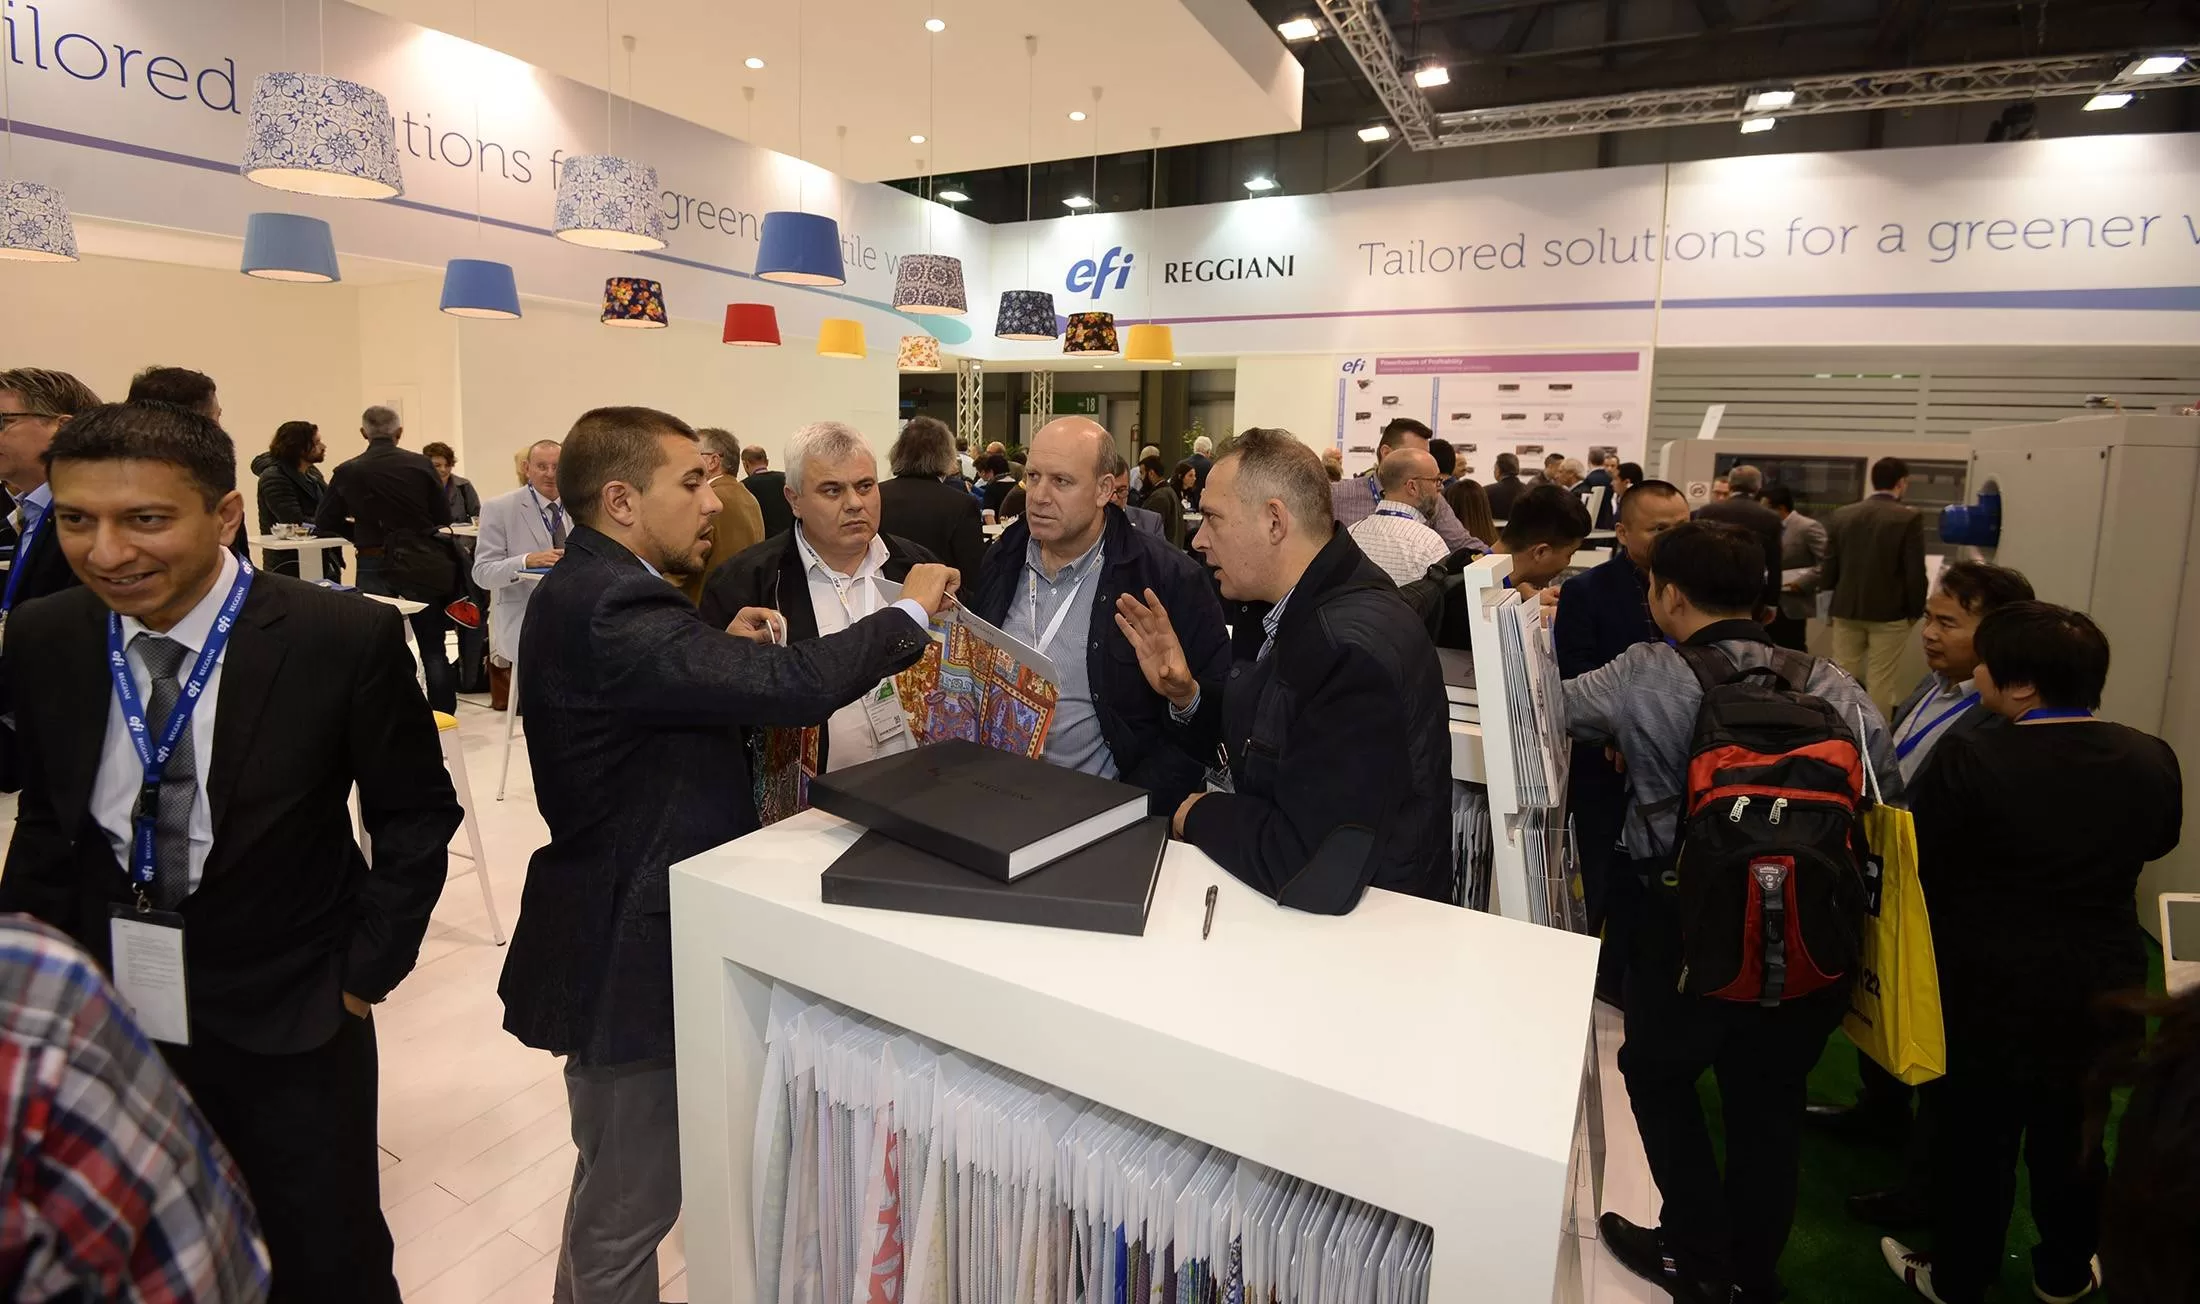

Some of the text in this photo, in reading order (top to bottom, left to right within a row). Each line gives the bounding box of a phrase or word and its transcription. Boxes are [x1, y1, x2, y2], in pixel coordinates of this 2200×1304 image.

[391, 111, 532, 183] tions
[661, 190, 764, 243] green
[1357, 232, 1527, 276] Tailored
[1542, 223, 1767, 268] solutions
[1785, 216, 1859, 256] for
[1876, 223, 1906, 255] a
[1927, 213, 2162, 264] greener
[1065, 246, 1295, 300] efi REGGIANI
[1342, 358, 1366, 374] efi
[1085, 397, 1096, 412] 18
[217, 615, 230, 633] efi
[112, 651, 124, 666] efi
[187, 680, 200, 697] efi
[129, 716, 144, 733] efi
[156, 746, 169, 763] efi
